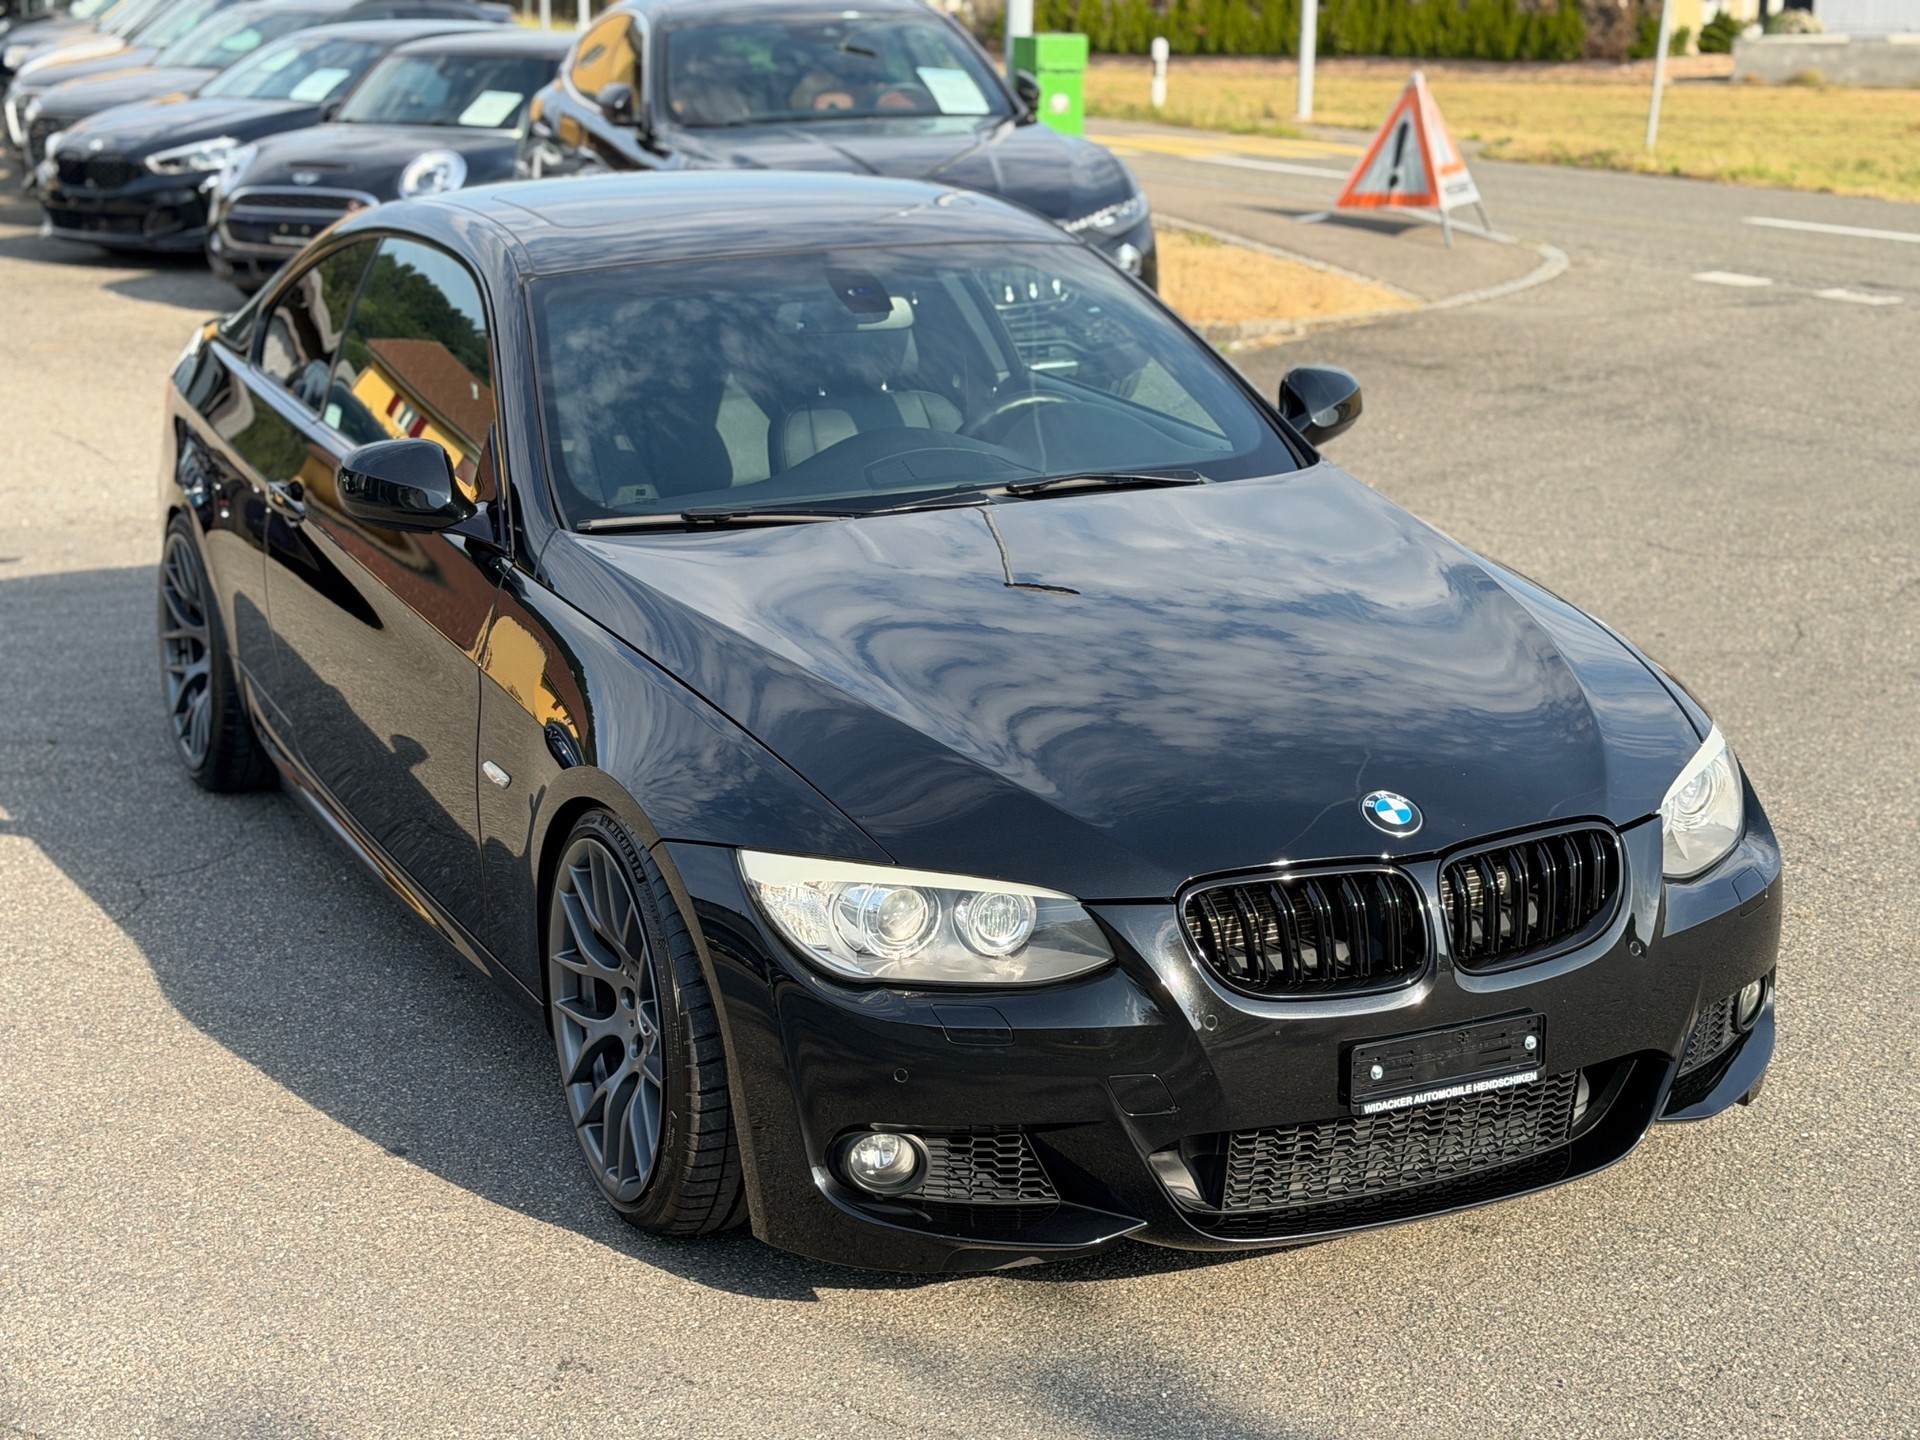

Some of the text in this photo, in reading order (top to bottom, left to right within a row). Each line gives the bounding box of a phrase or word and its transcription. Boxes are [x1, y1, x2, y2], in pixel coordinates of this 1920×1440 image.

[607, 821, 645, 880] MICHELIN
[1364, 1071, 1538, 1114] WIDACKER AUTOMOBILE HENDSCHIKEN
